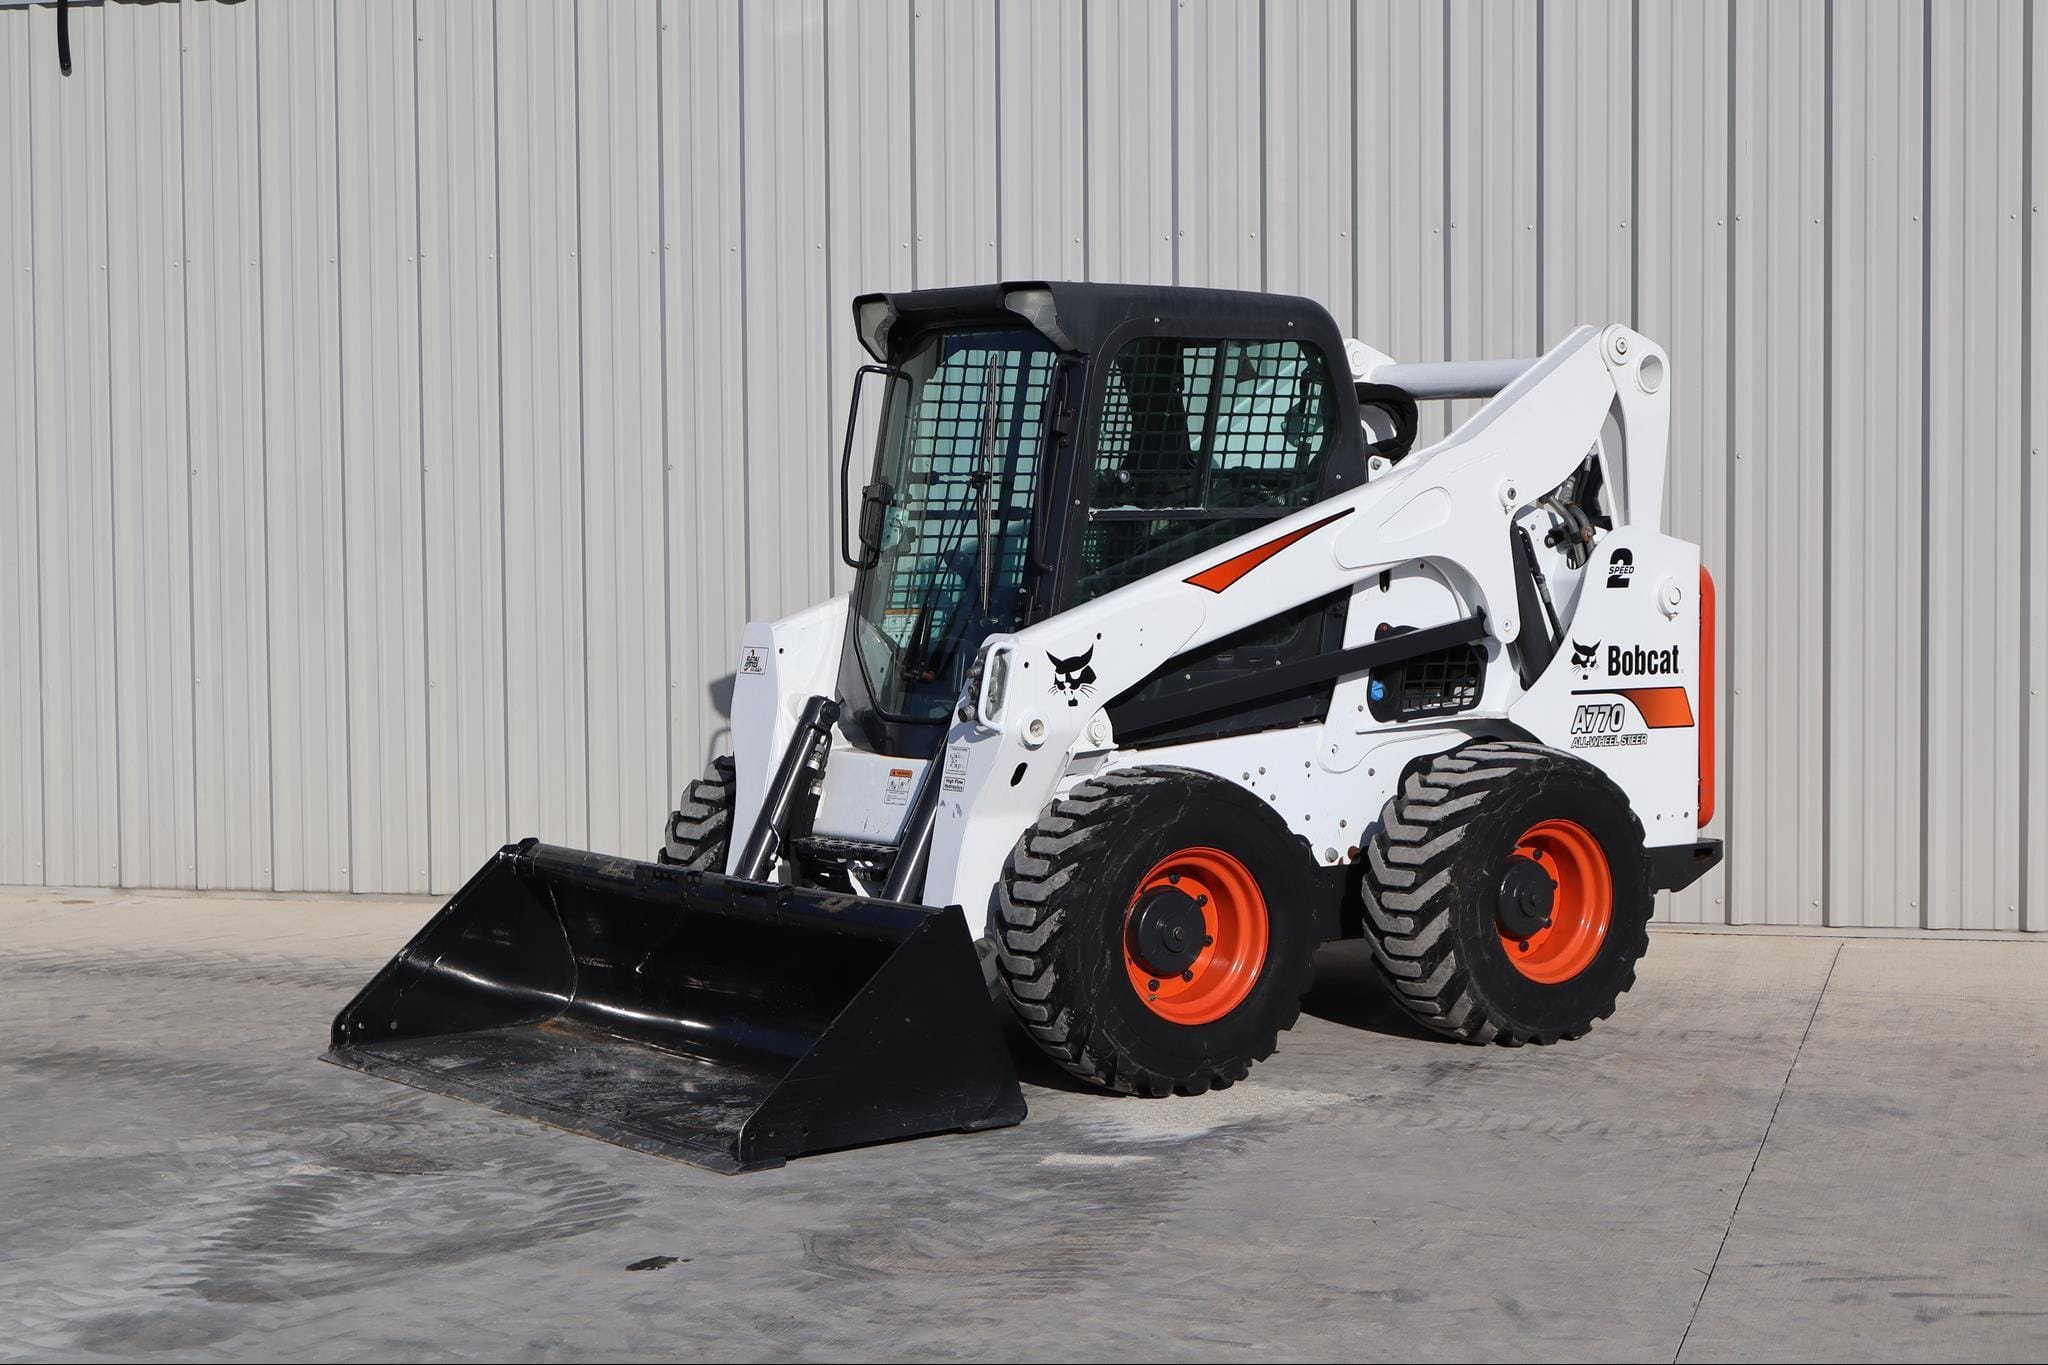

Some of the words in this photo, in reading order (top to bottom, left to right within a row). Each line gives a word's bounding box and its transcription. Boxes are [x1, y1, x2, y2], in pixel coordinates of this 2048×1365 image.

[1606, 548, 1633, 588] 2
[1608, 566, 1635, 575] SPEED
[1608, 645, 1679, 676] Bobcat
[1571, 703, 1625, 734] A770
[1571, 735, 1619, 749] ALL-WHEEL
[1620, 733, 1648, 746] STEER
